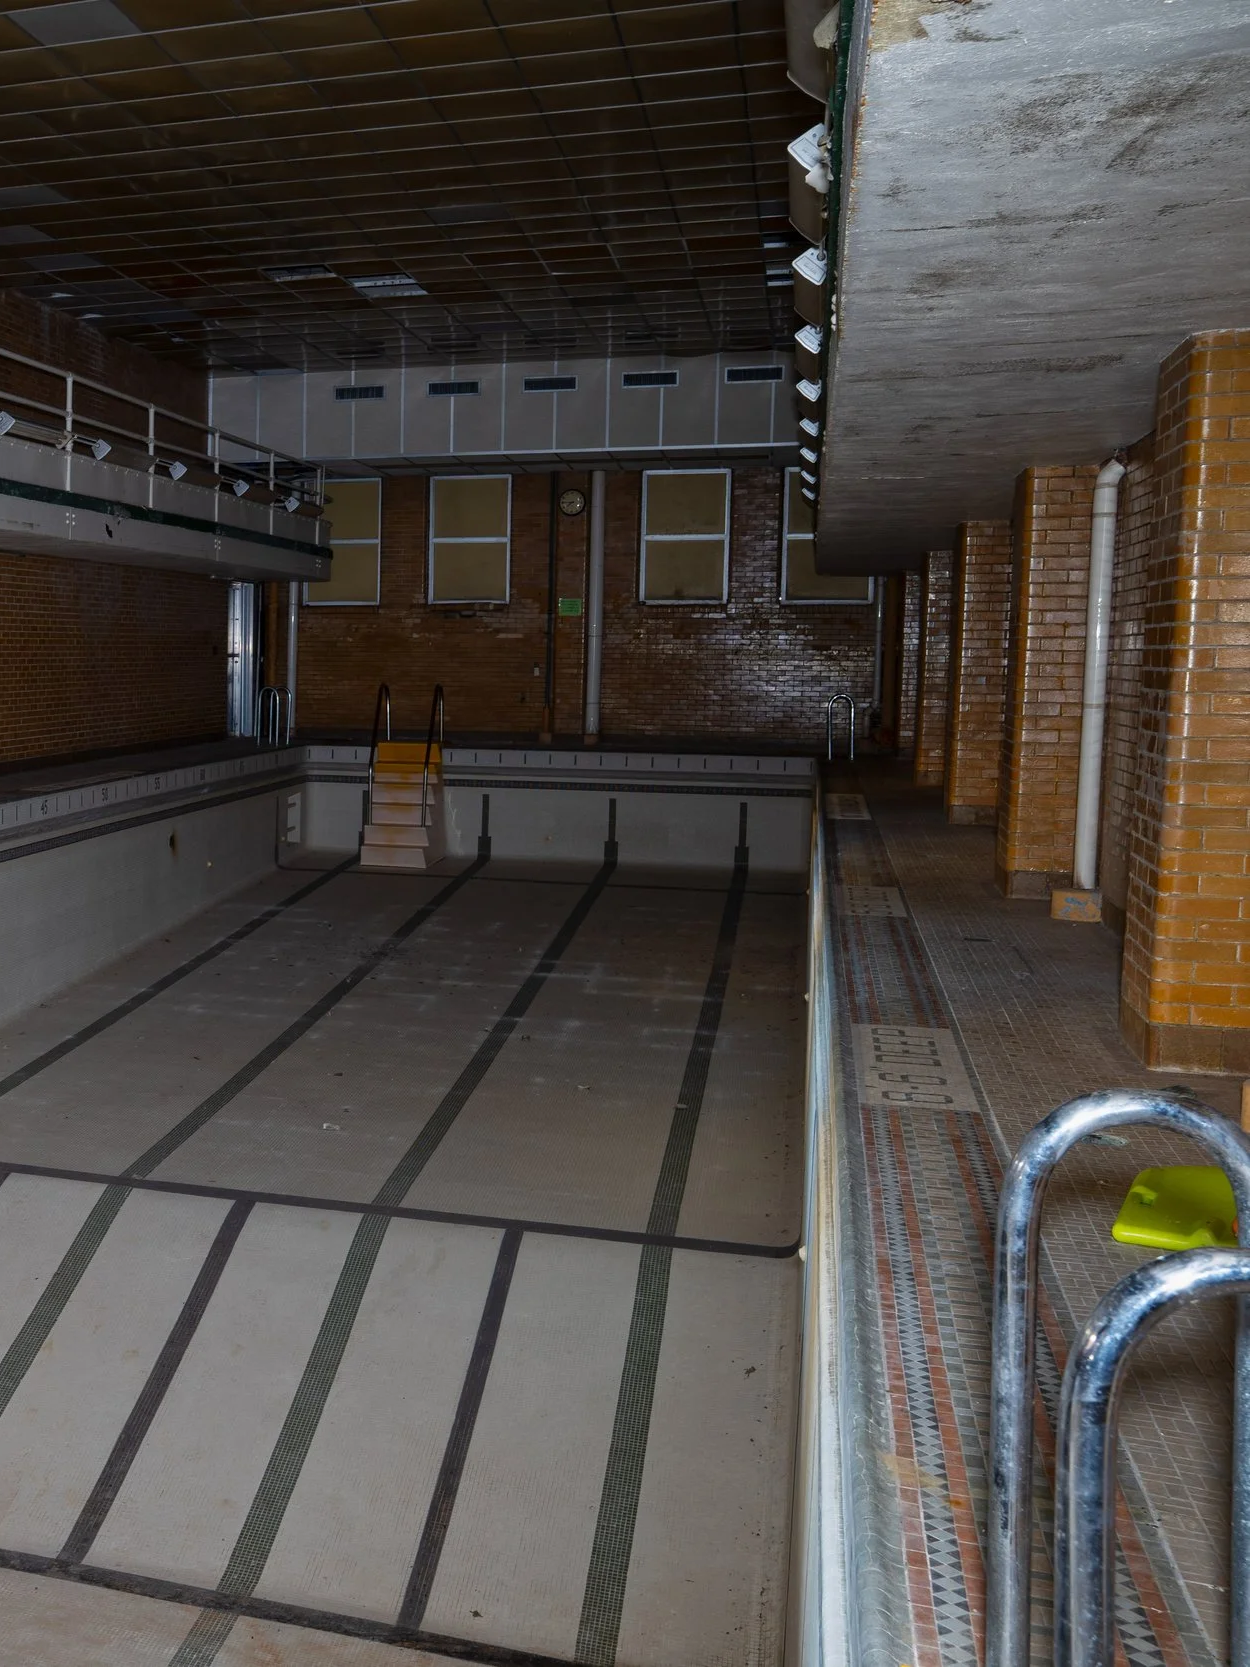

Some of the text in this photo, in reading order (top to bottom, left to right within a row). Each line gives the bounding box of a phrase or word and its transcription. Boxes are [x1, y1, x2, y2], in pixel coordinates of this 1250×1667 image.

[154, 777, 161, 791] 55
[101, 787, 109, 802] 50
[40, 799, 49, 816] 45
[871, 1027, 942, 1066] DEEP
